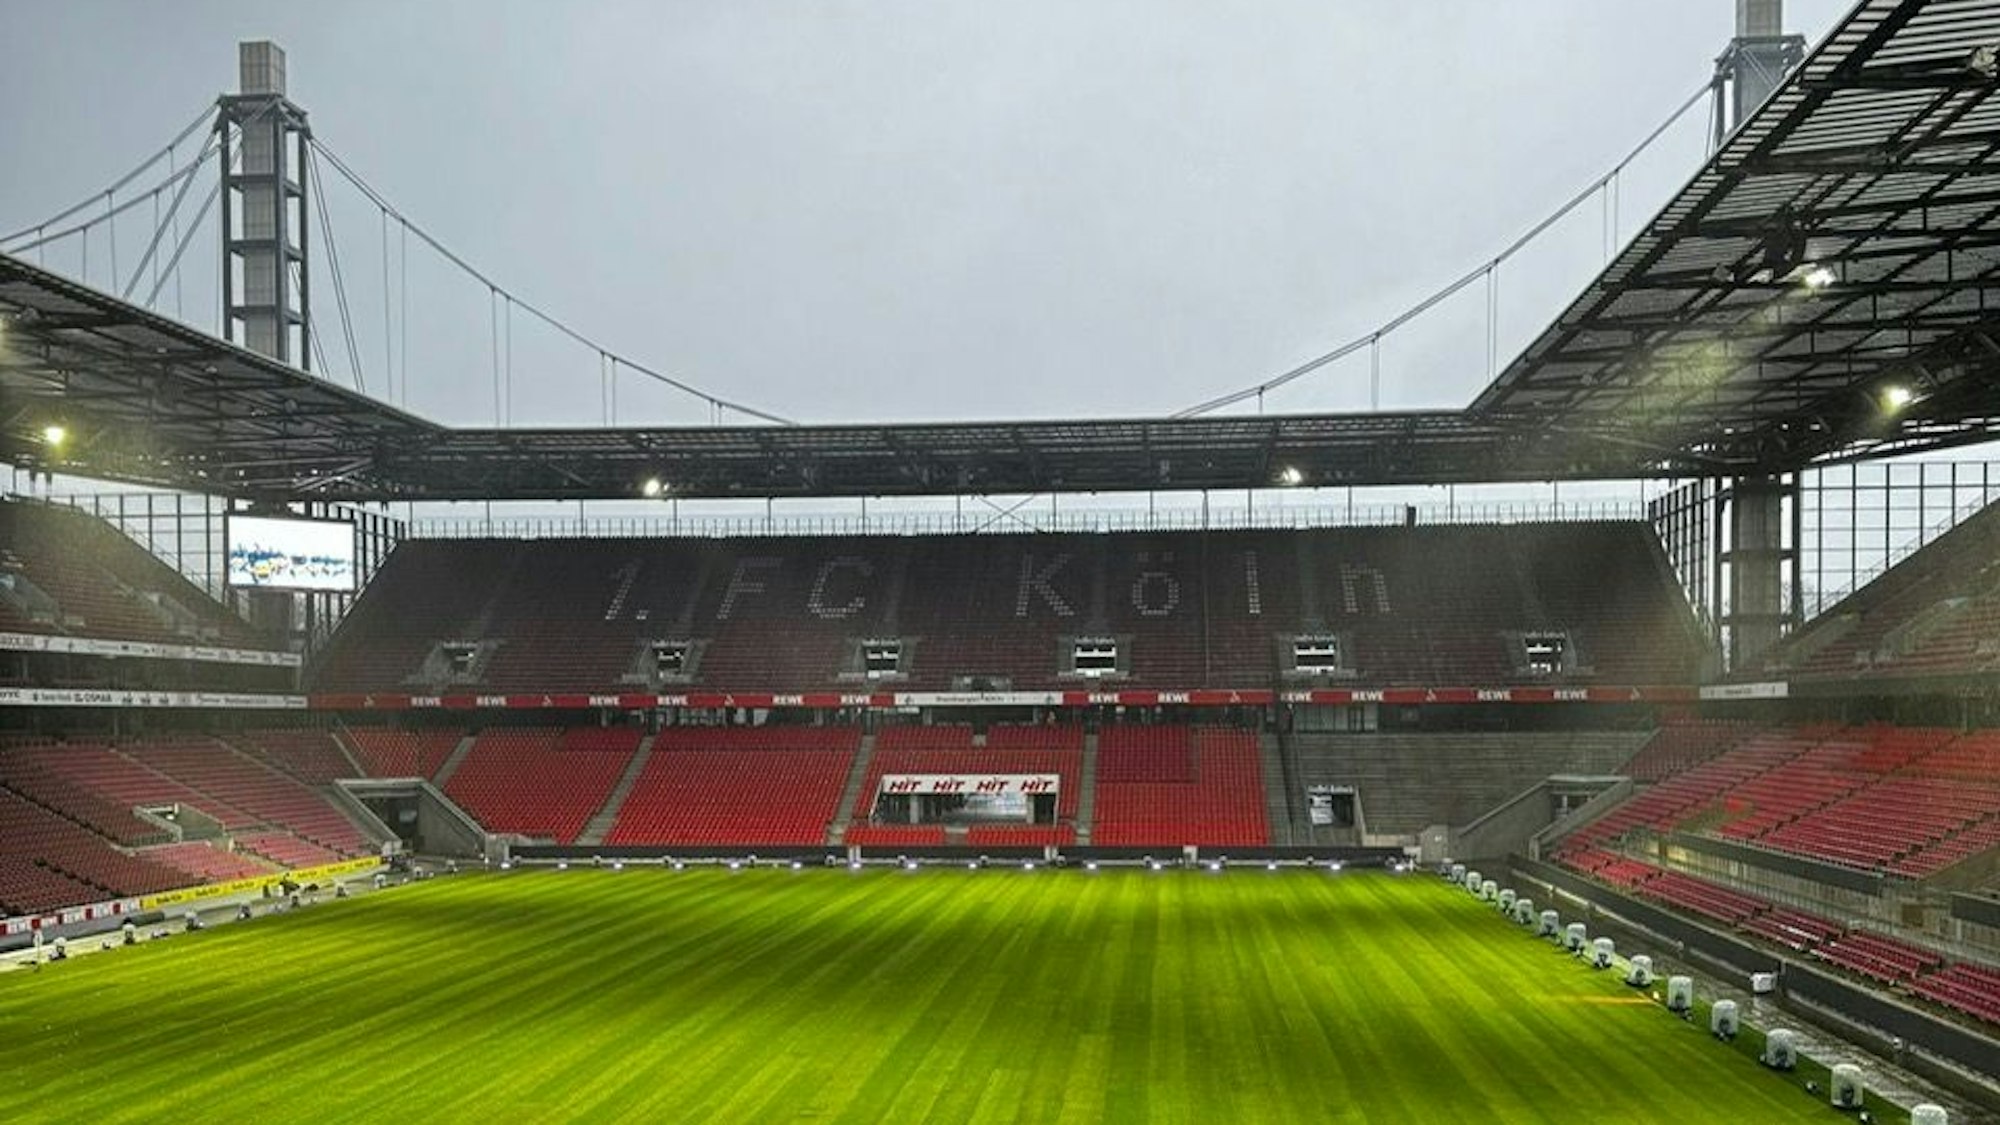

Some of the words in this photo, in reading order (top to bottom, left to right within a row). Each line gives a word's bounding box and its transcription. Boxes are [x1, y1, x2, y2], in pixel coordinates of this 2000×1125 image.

[604, 558, 649, 620] 1.
[716, 556, 875, 620] FC
[1016, 551, 1393, 616] Köln
[772, 695, 804, 705] REWE
[840, 695, 871, 705] REWE
[1088, 693, 1119, 703] REWE
[1158, 693, 1189, 703] REWE
[1351, 691, 1384, 701] REWE
[1477, 691, 1511, 701] REWE
[1553, 690, 1588, 700] REWE
[411, 697, 441, 707] REWE
[476, 697, 507, 706] REWE
[589, 696, 620, 706] REWE
[657, 696, 688, 705] REWE
